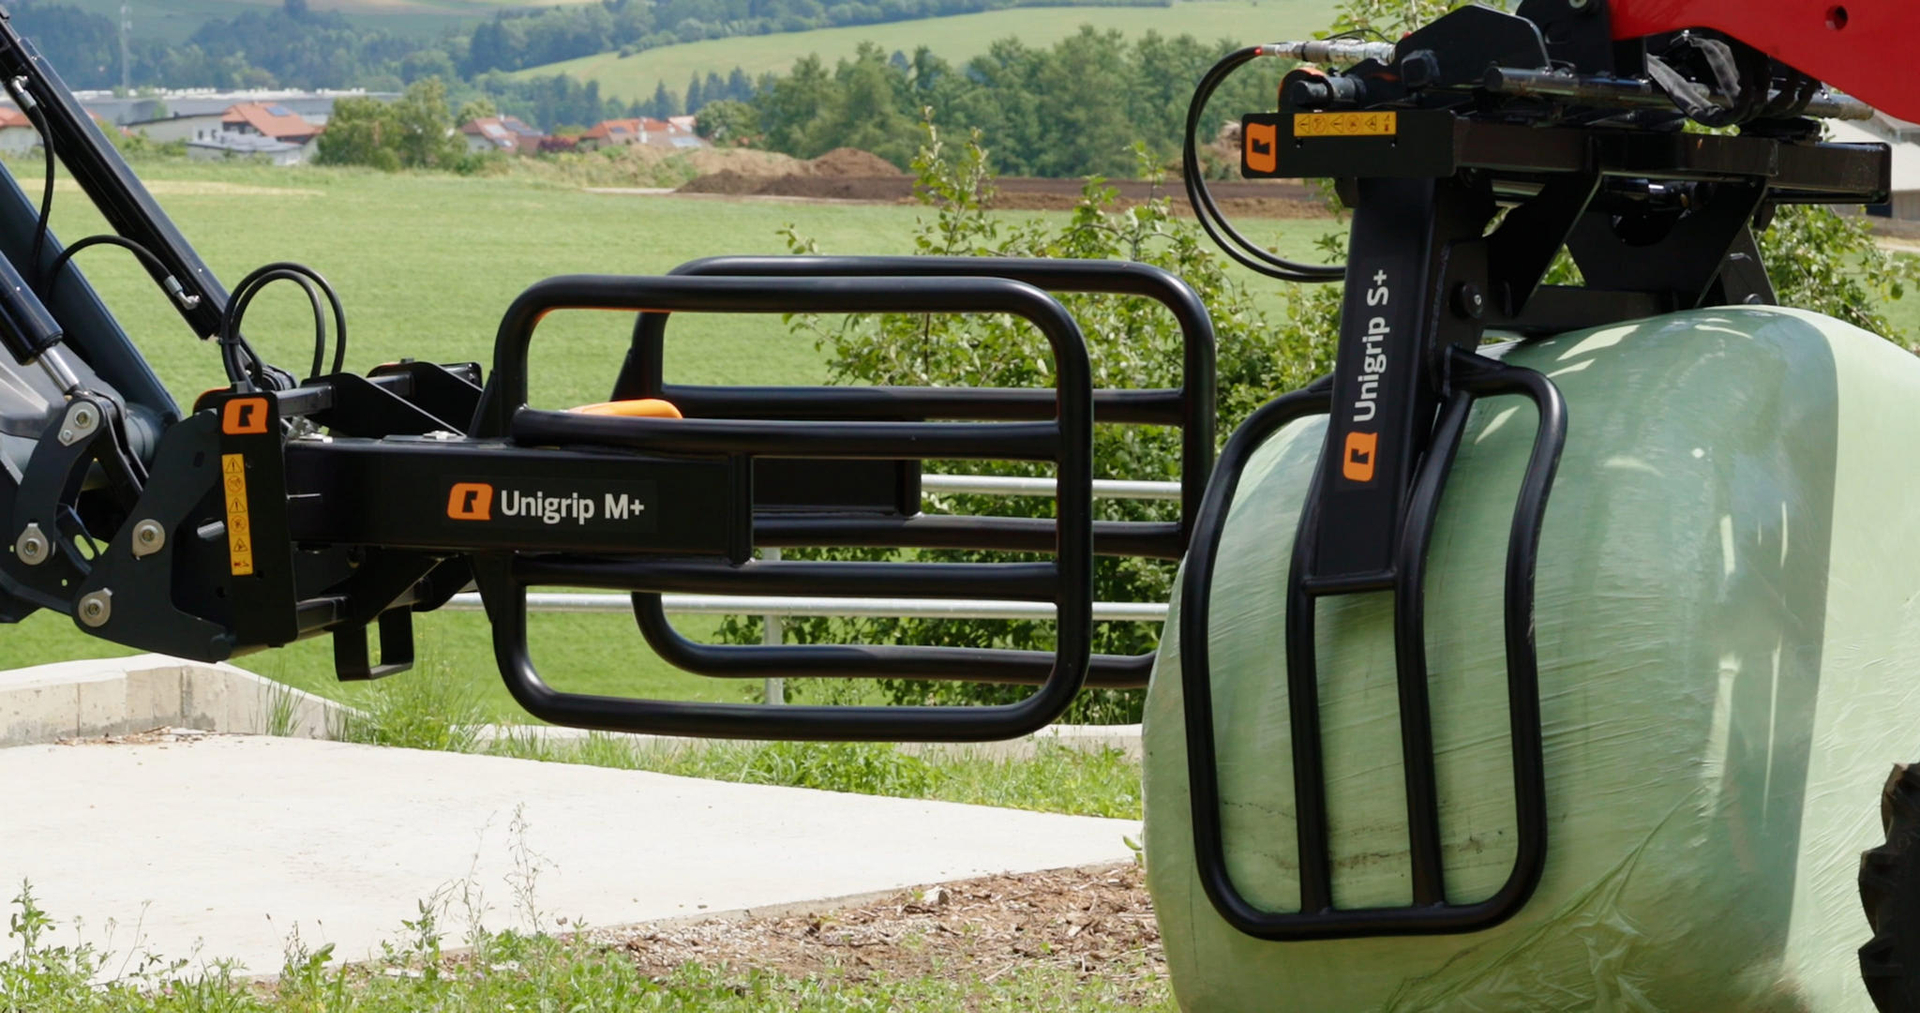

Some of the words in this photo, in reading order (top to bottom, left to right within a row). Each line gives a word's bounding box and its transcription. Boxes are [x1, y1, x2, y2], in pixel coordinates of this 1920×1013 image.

[1366, 269, 1389, 307] S+
[1352, 316, 1391, 422] Unigrip
[501, 489, 595, 525] Unigrip
[604, 493, 645, 520] M+
